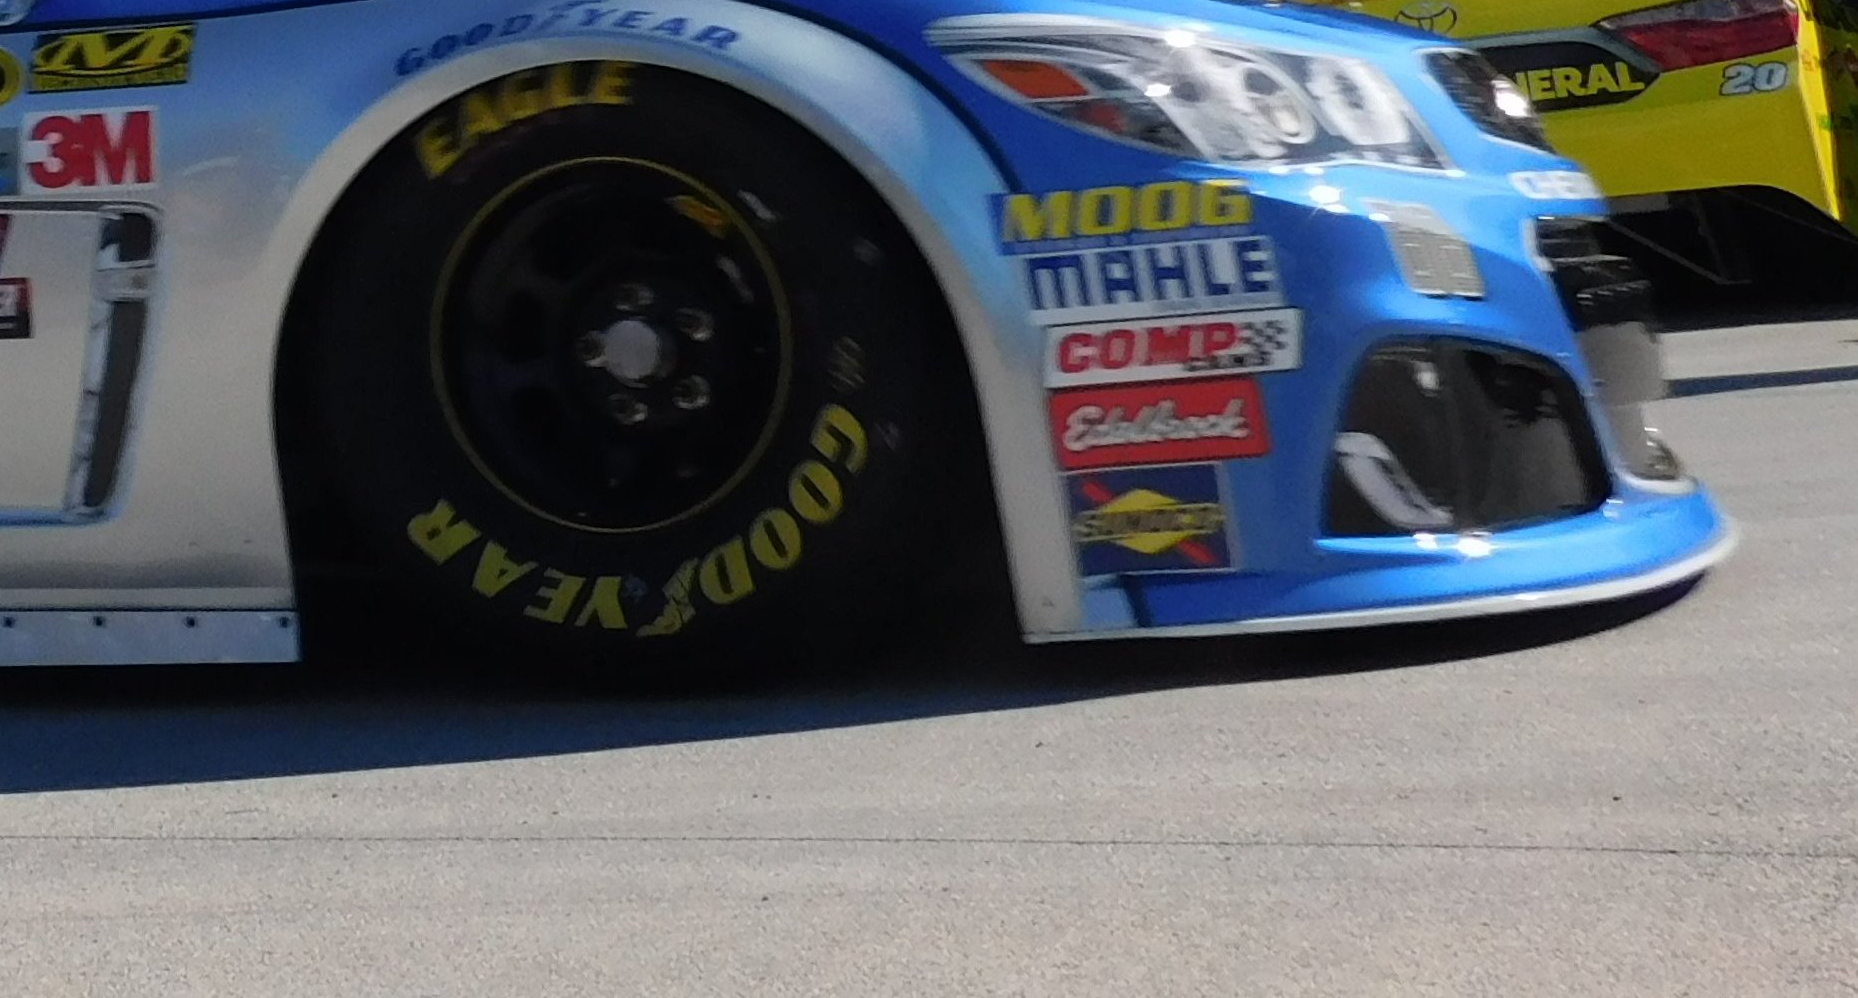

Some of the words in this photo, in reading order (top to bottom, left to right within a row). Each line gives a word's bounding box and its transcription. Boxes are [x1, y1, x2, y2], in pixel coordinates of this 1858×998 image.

[1513, 61, 1645, 103] NERAL
[1718, 61, 1788, 97] 20
[27, 111, 152, 189] 3M
[412, 58, 640, 180] EAGLE
[1000, 179, 1253, 242] MOOG
[1026, 238, 1276, 310] MAHLE
[1056, 321, 1239, 374] COMP
